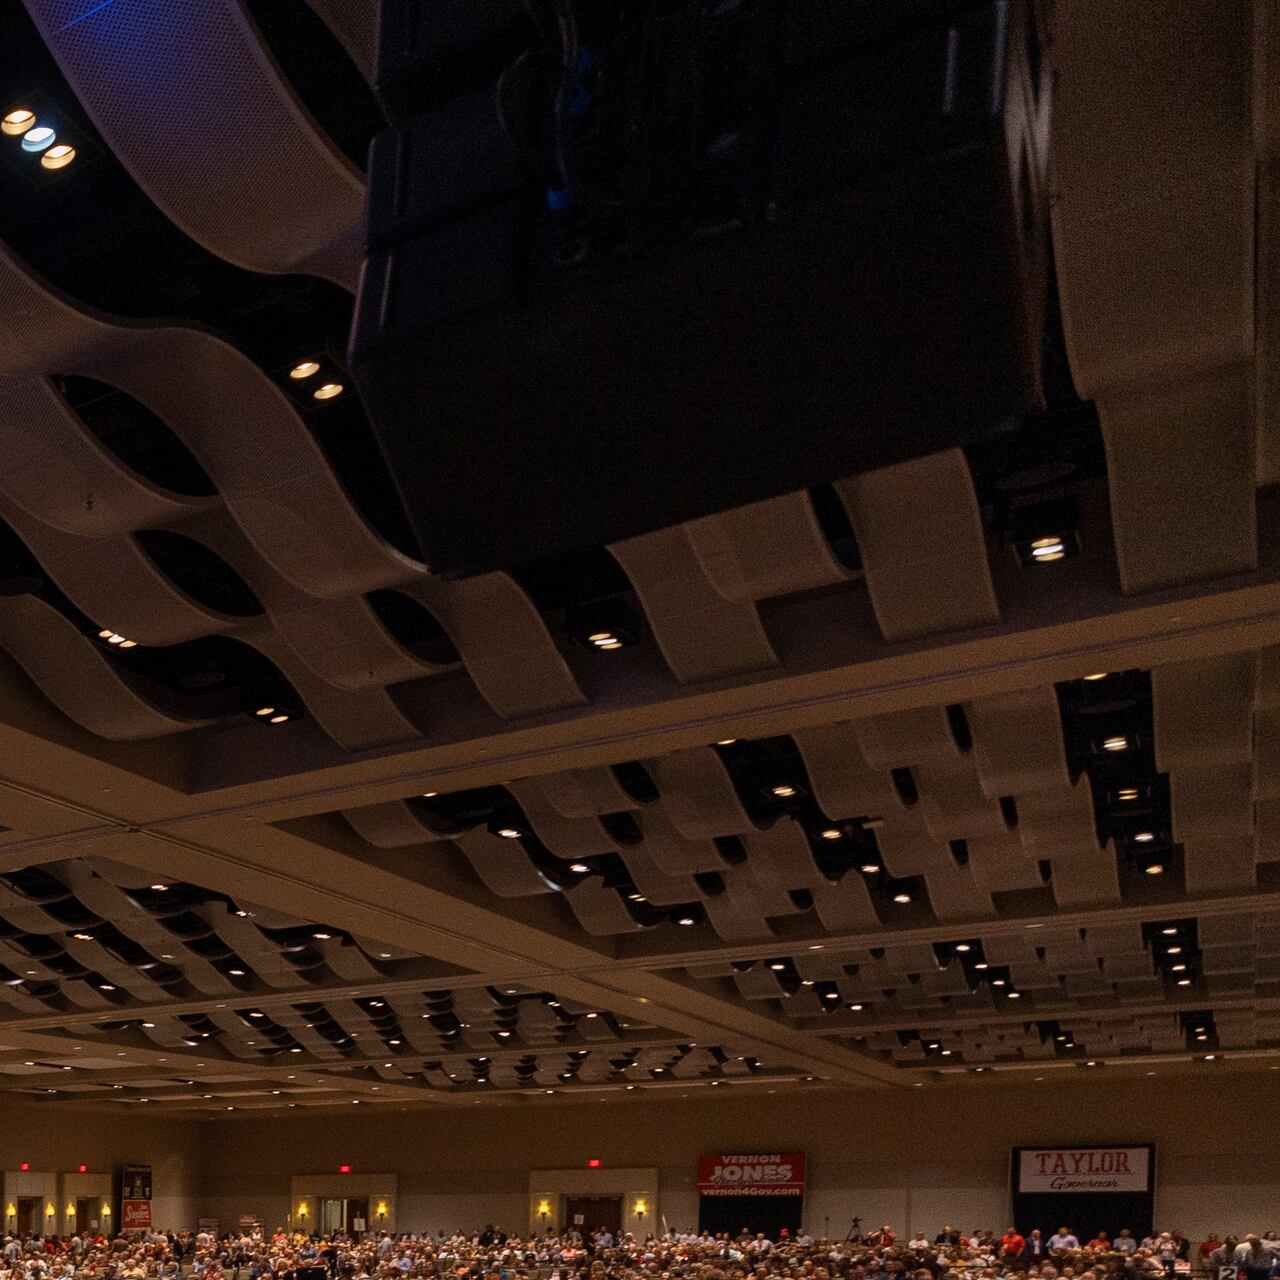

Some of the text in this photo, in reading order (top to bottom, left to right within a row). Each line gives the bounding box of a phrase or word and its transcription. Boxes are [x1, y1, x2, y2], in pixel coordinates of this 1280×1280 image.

[721, 1154, 781, 1164] VERNON
[1035, 1152, 1131, 1174] TAYLOR
[709, 1165, 793, 1181] JONES
[1050, 1177, 1119, 1190] Governor
[1221, 1267, 1235, 1280] 2
